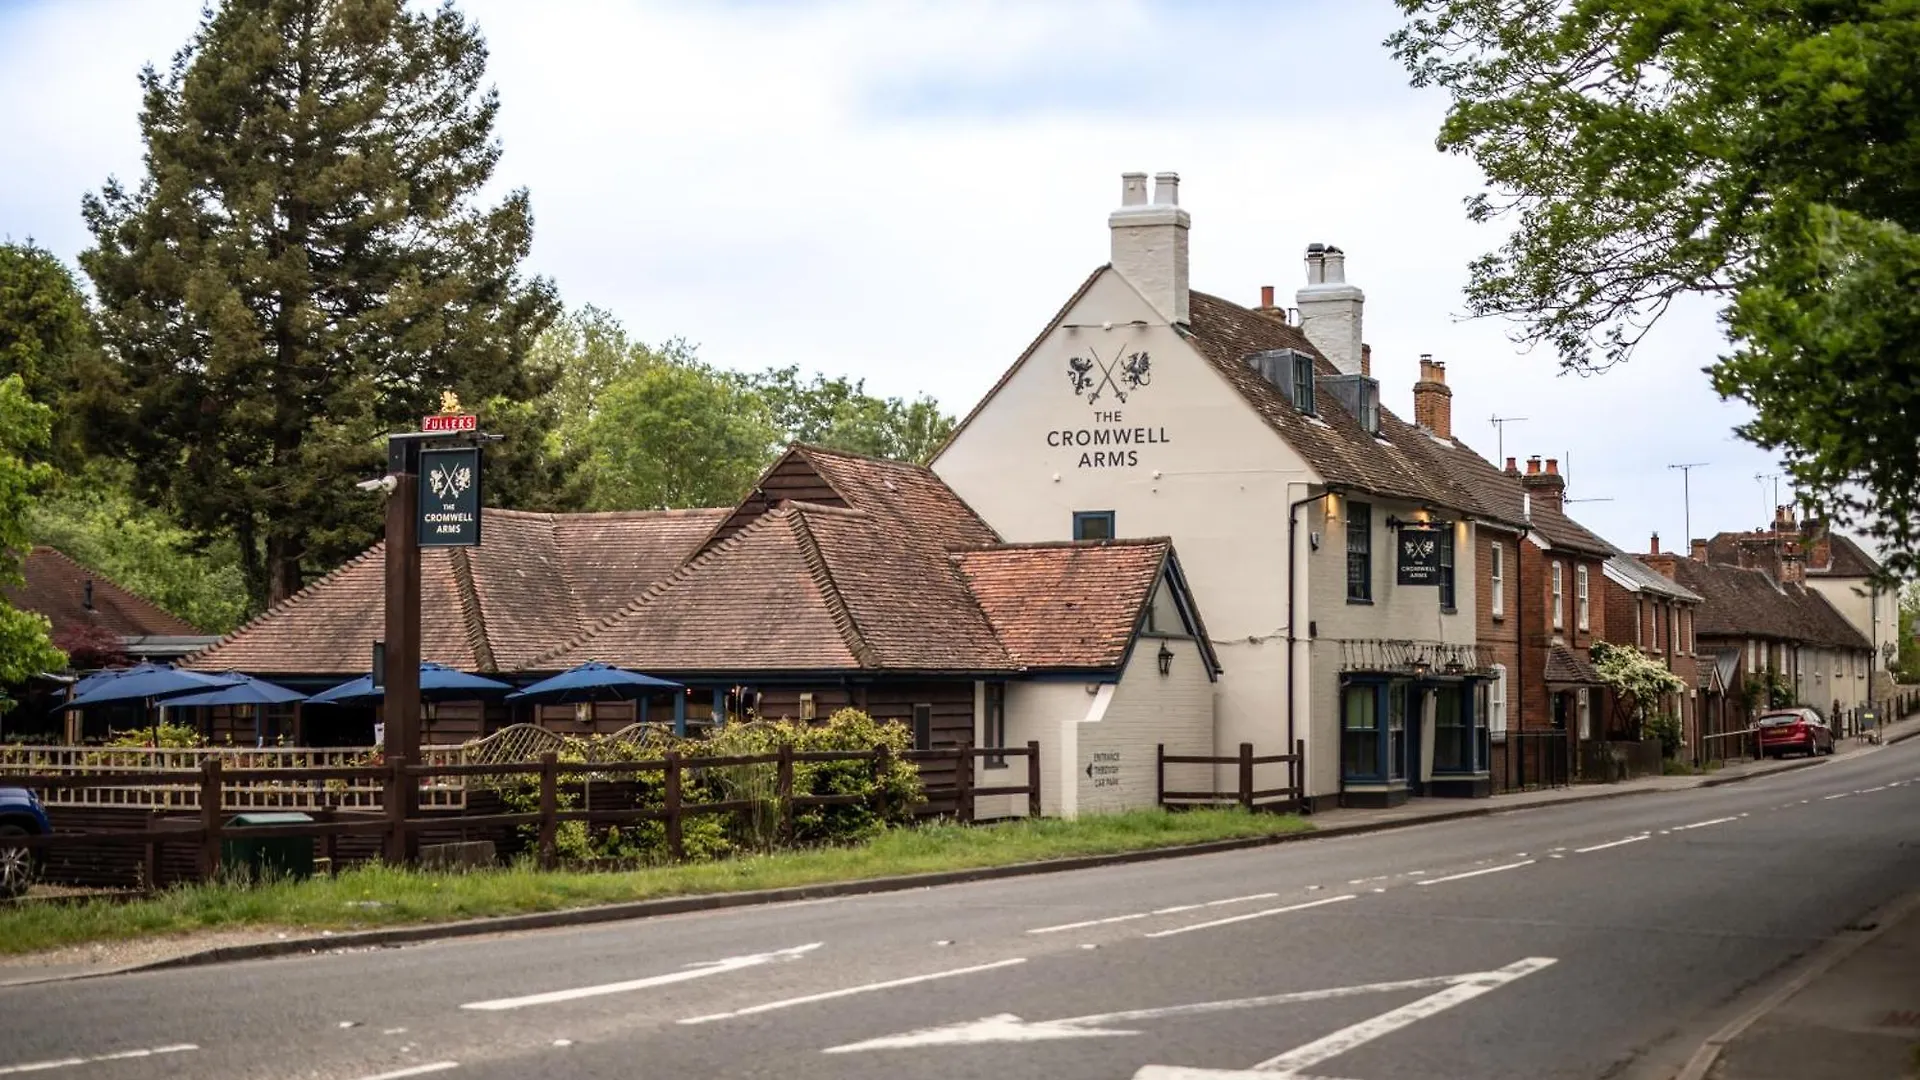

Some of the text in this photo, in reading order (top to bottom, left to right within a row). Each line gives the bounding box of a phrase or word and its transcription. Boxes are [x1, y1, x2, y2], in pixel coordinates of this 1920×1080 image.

[1094, 411, 1122, 422] THE
[1047, 427, 1170, 446] CROMWELL
[1078, 450, 1138, 468] ARMS
[443, 503, 455, 511] THE
[424, 512, 473, 523] CROMWELL
[436, 525, 461, 533] ARMS
